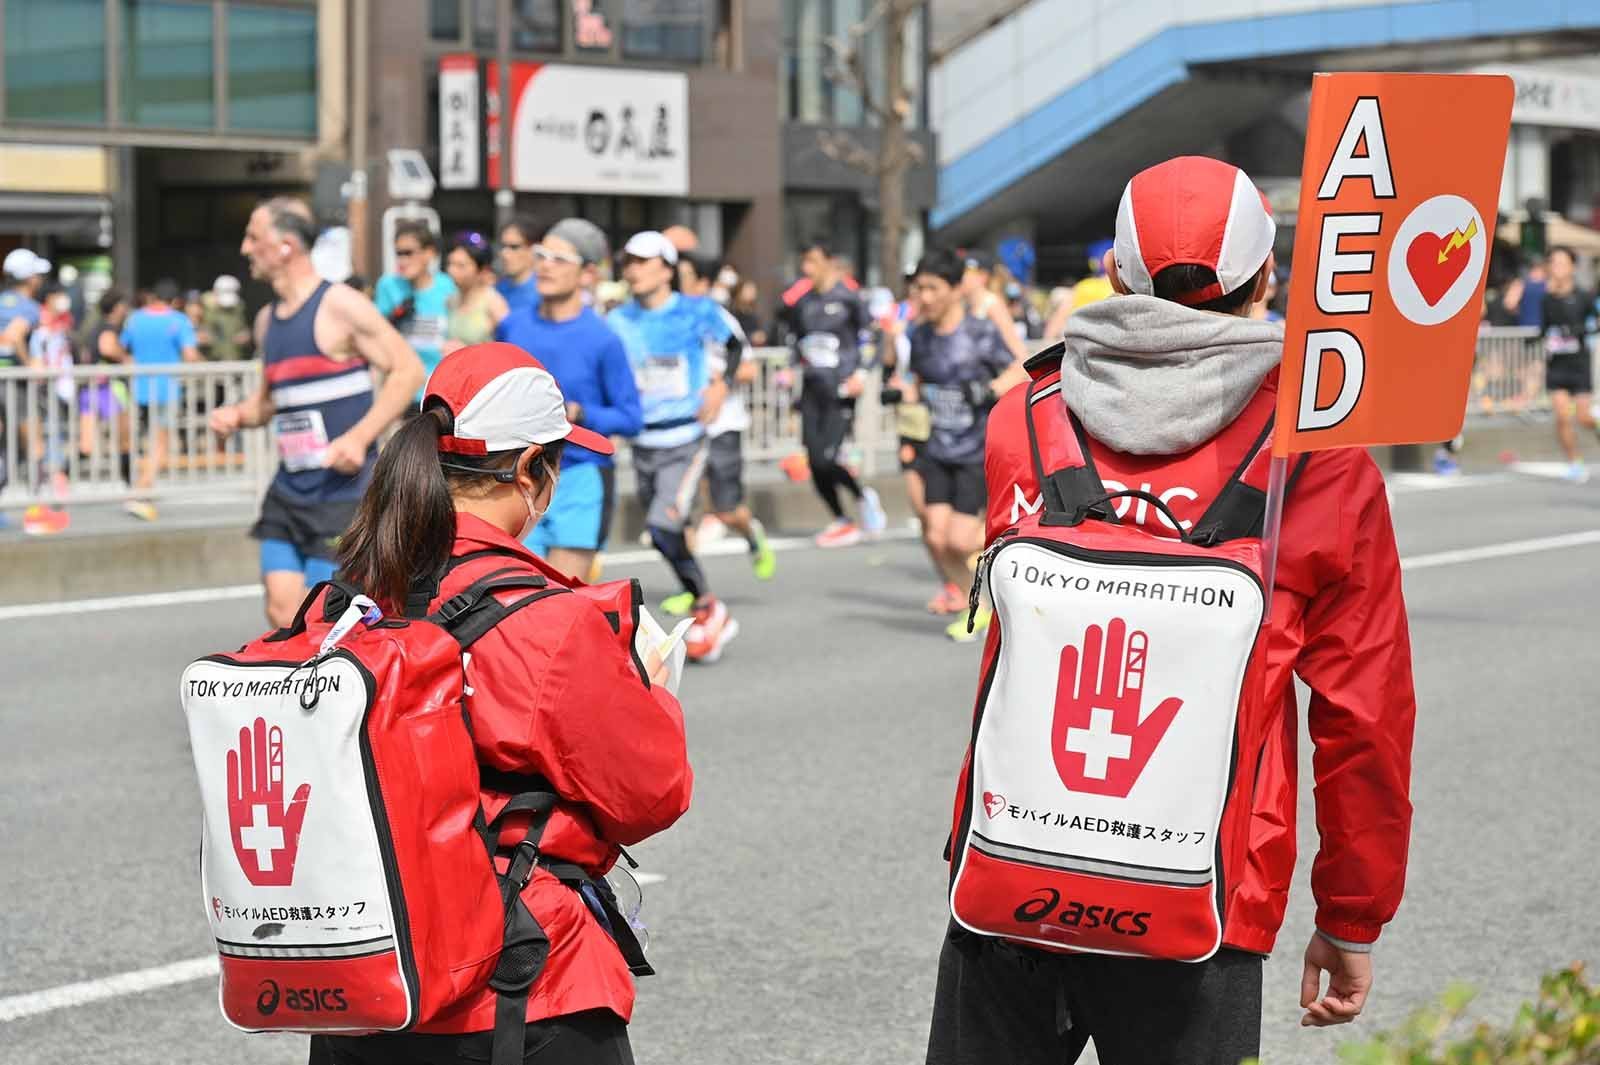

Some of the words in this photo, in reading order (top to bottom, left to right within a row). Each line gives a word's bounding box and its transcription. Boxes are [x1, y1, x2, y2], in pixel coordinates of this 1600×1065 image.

[1296, 96, 1397, 433] AED
[1009, 479, 1199, 531] MDIC
[1010, 560, 1090, 590] TOKYO
[1096, 579, 1235, 608] MARATHON
[189, 679, 244, 698] TOKYO
[245, 674, 341, 698] MARATHON
[1007, 804, 1206, 845] モバイルAED救護スタッフ
[224, 901, 366, 921] モバイルAED救護スタッフ
[1058, 901, 1152, 936] asics
[285, 988, 348, 1011] asics
